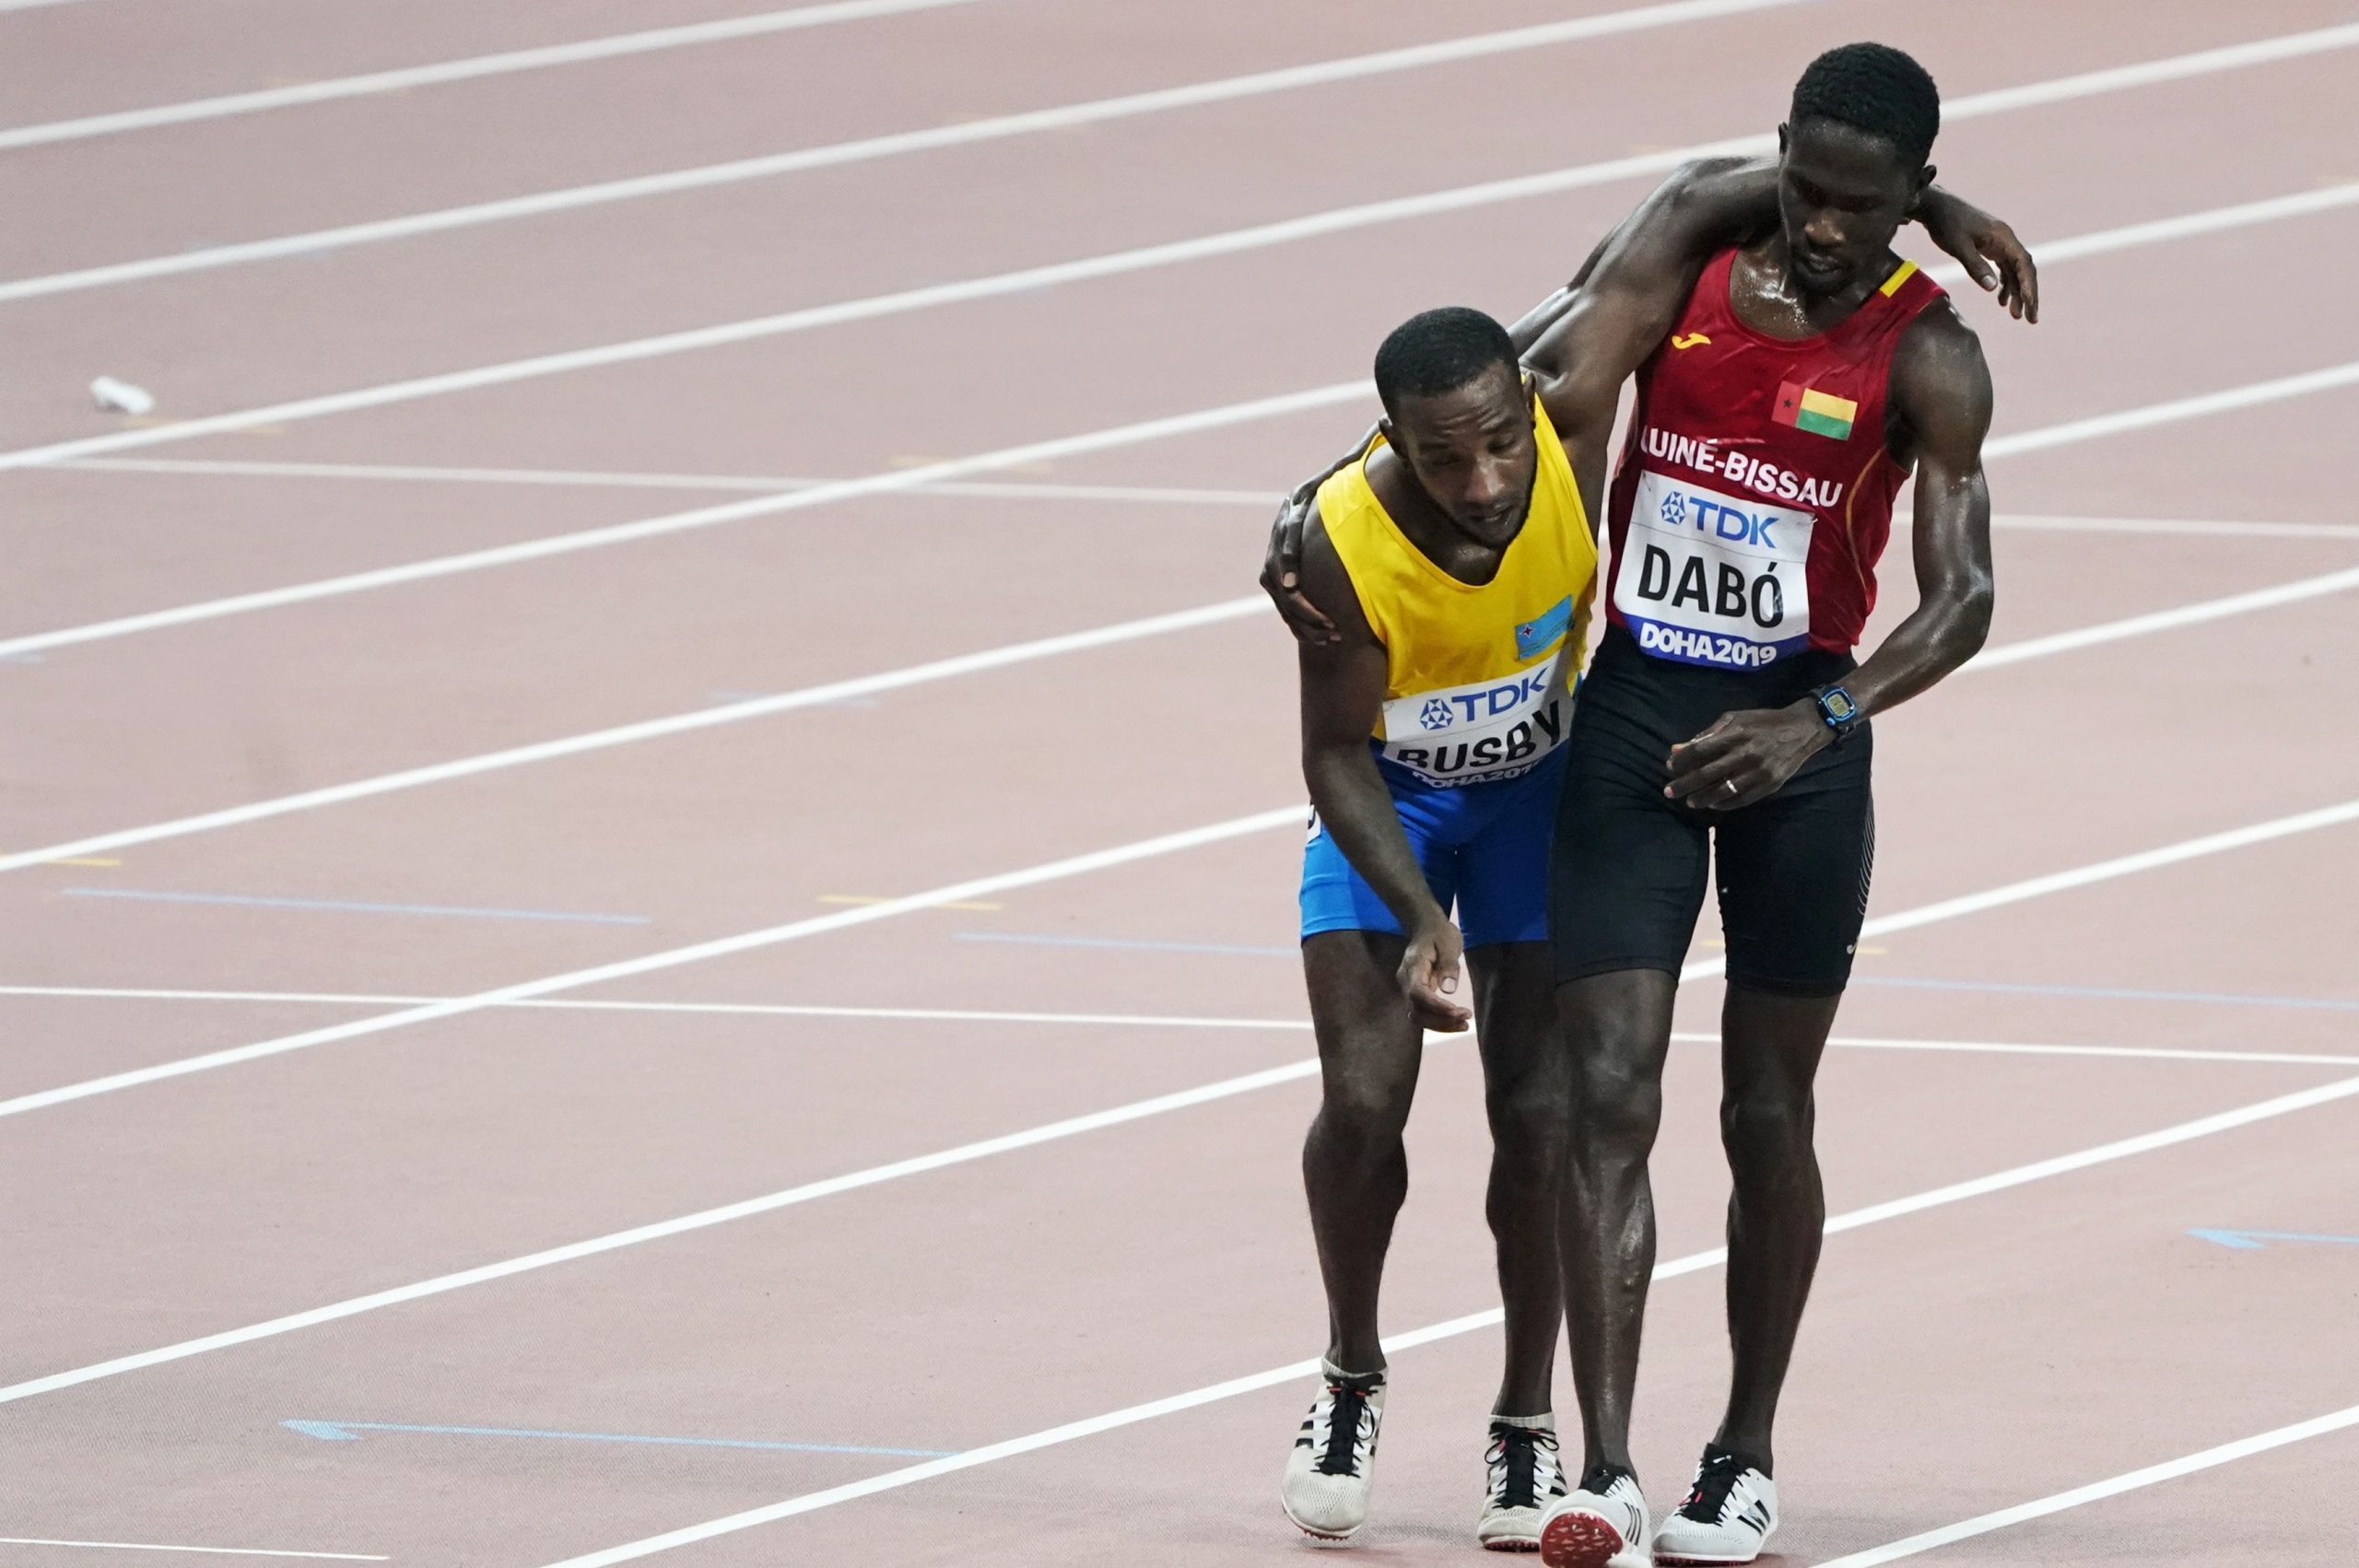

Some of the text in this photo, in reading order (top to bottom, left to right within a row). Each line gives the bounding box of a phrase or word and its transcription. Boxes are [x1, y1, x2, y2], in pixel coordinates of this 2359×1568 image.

[1689, 497, 1778, 549] TDK
[1637, 544, 1784, 628] DABÓ
[1639, 625, 1777, 667] DOHA2019
[1452, 666, 1549, 722] TDK
[1397, 699, 1560, 772] BUSBY
[1412, 760, 1540, 789] OHA201
